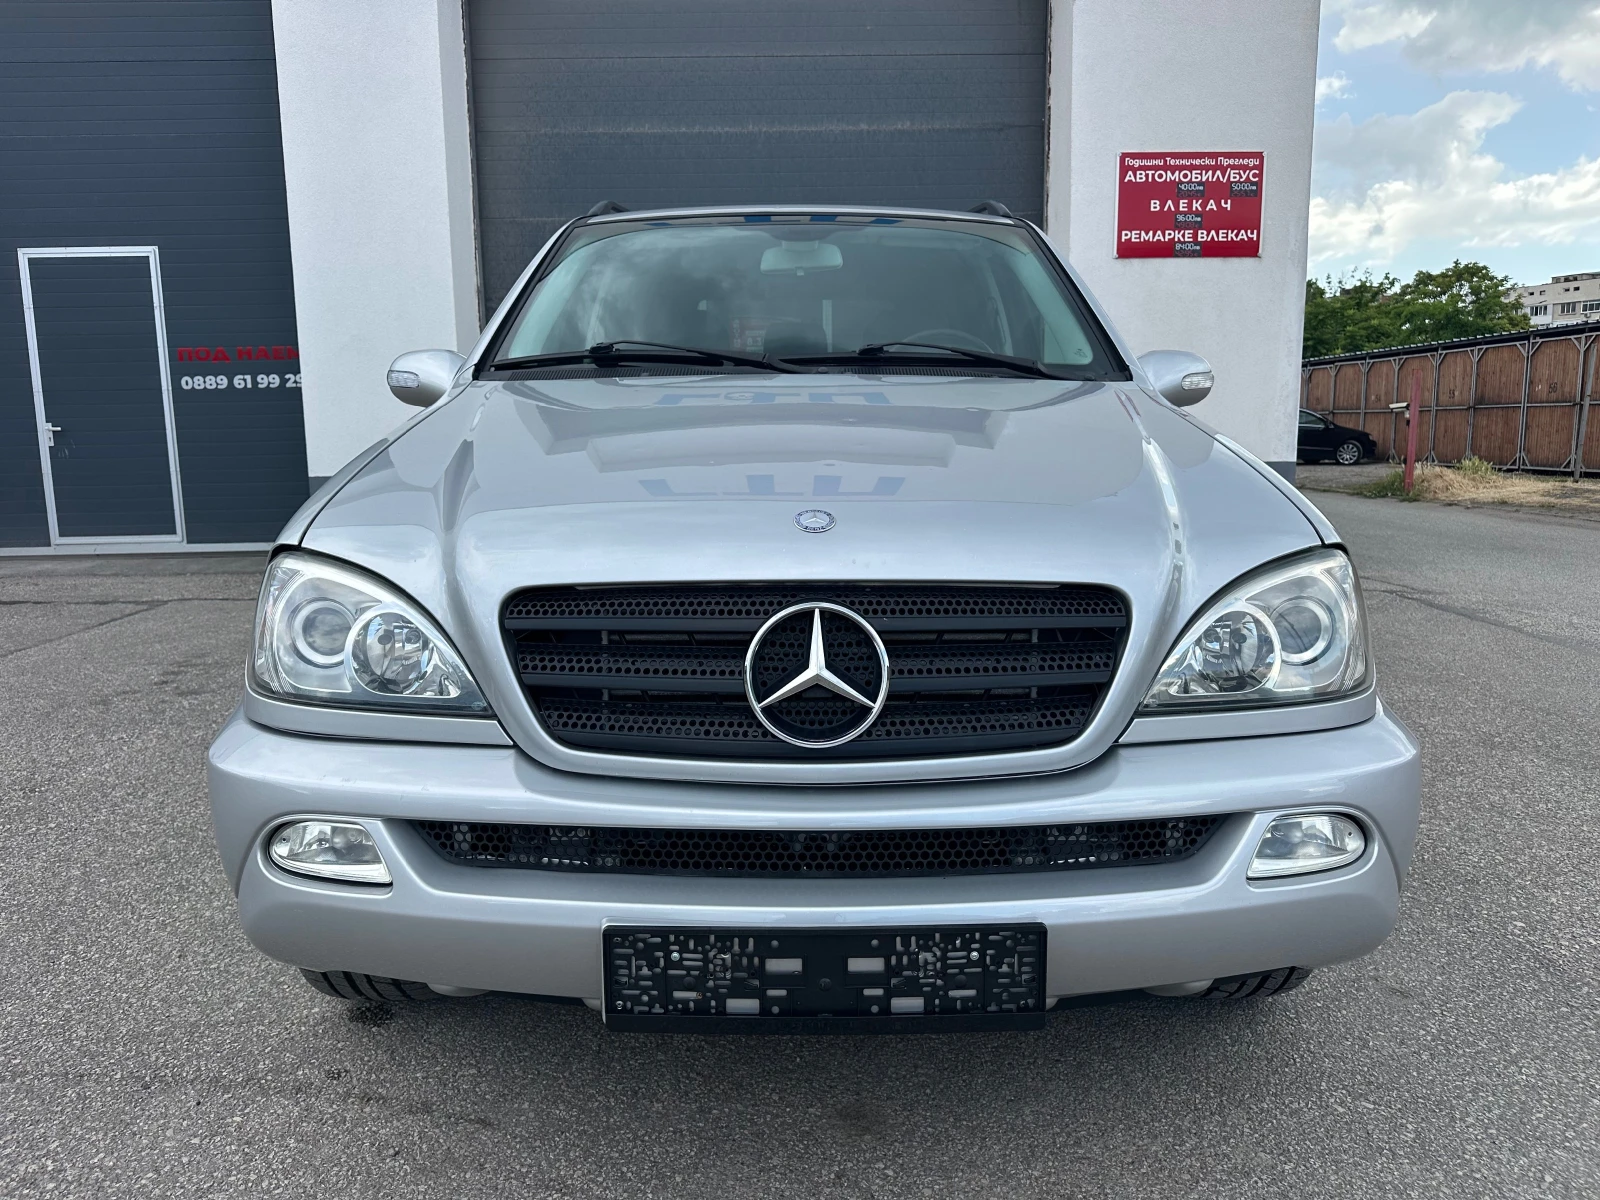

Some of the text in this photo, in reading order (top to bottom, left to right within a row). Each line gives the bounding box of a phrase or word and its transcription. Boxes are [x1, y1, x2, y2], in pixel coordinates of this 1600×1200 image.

[1124, 157, 1260, 167] Годишни Технически Прегледи
[1124, 168, 1260, 183] АВТОМОБИЛ/БУС
[1150, 199, 1231, 211] ВЛЕКАЧ
[1121, 230, 1257, 242] РЕМАРКЕ ВЛЕКАЧ
[177, 346, 231, 363] ПОД
[181, 375, 229, 390] 0889
[233, 374, 252, 389] 61
[257, 374, 281, 388] 99
